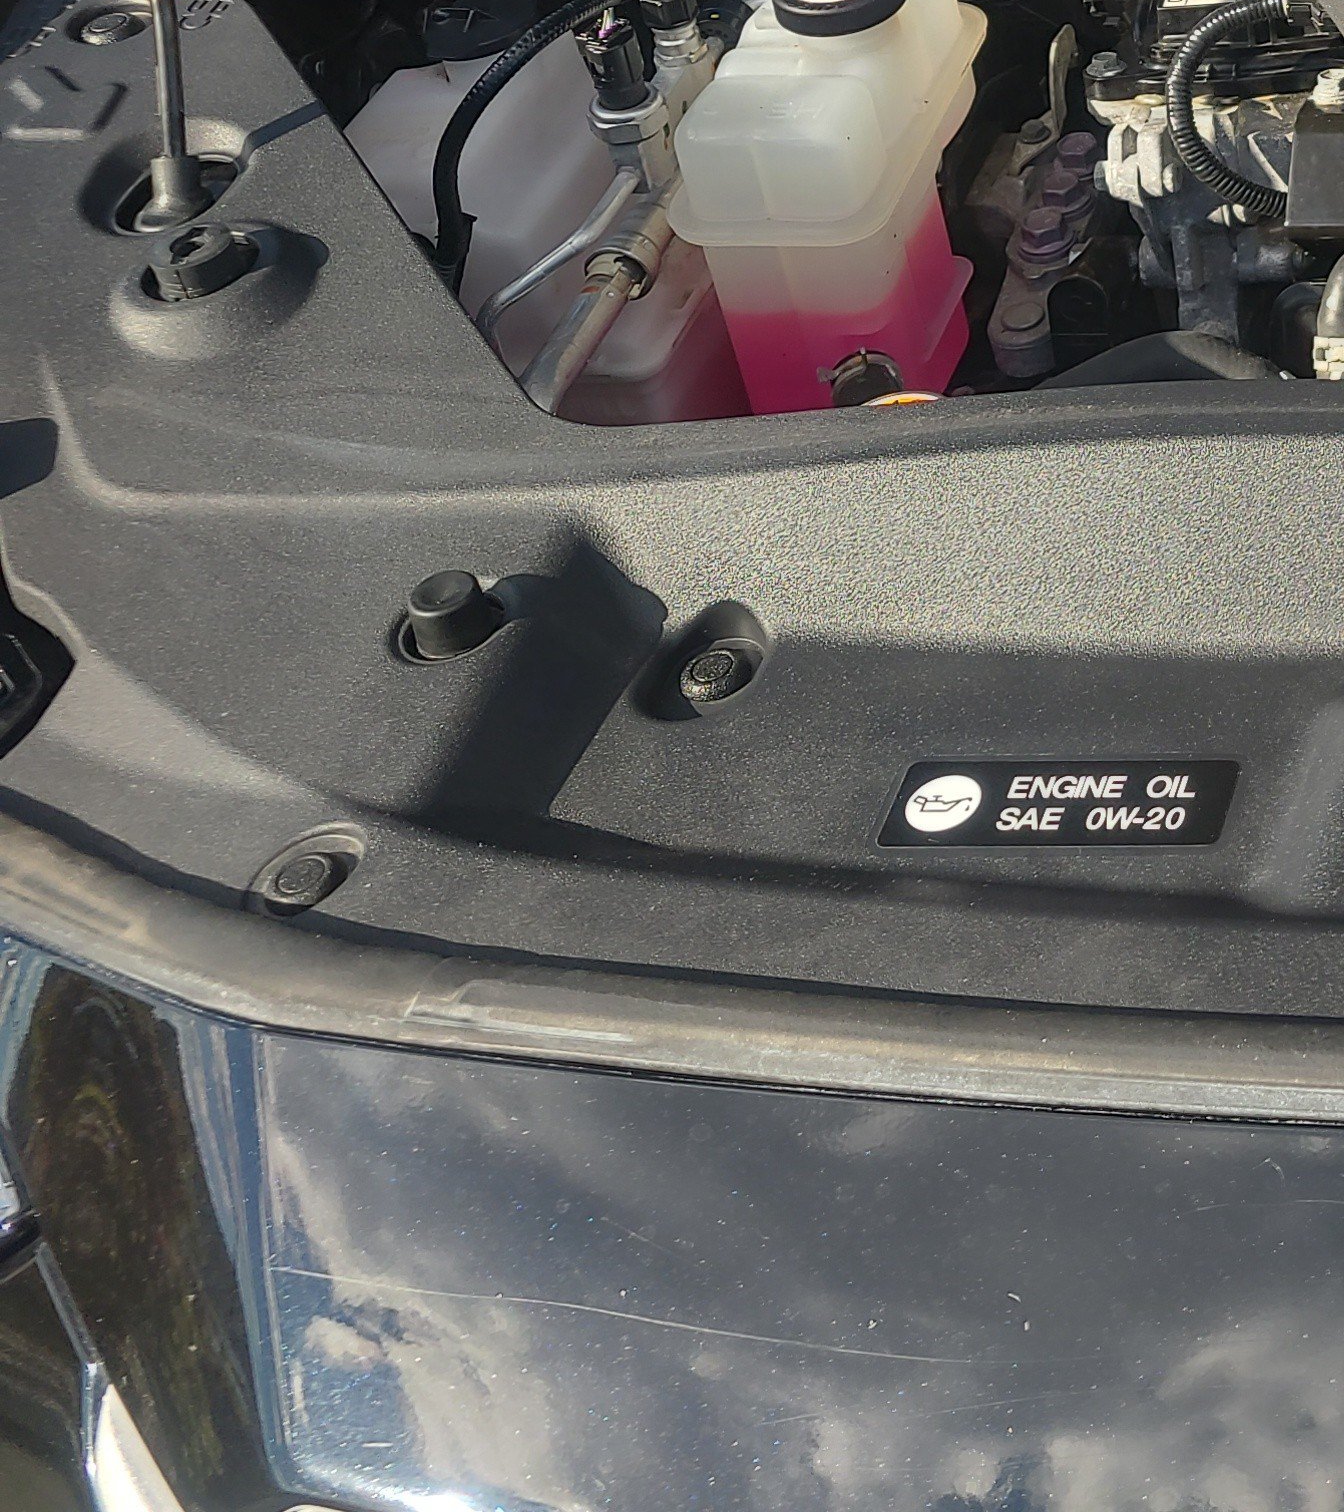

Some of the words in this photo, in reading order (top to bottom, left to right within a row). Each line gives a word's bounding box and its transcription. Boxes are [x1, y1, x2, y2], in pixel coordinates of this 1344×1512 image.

[1006, 774, 1128, 800] ENGINE
[1145, 774, 1197, 799] OIL
[995, 806, 1066, 831] SAE
[1085, 806, 1186, 831] 0W-20
